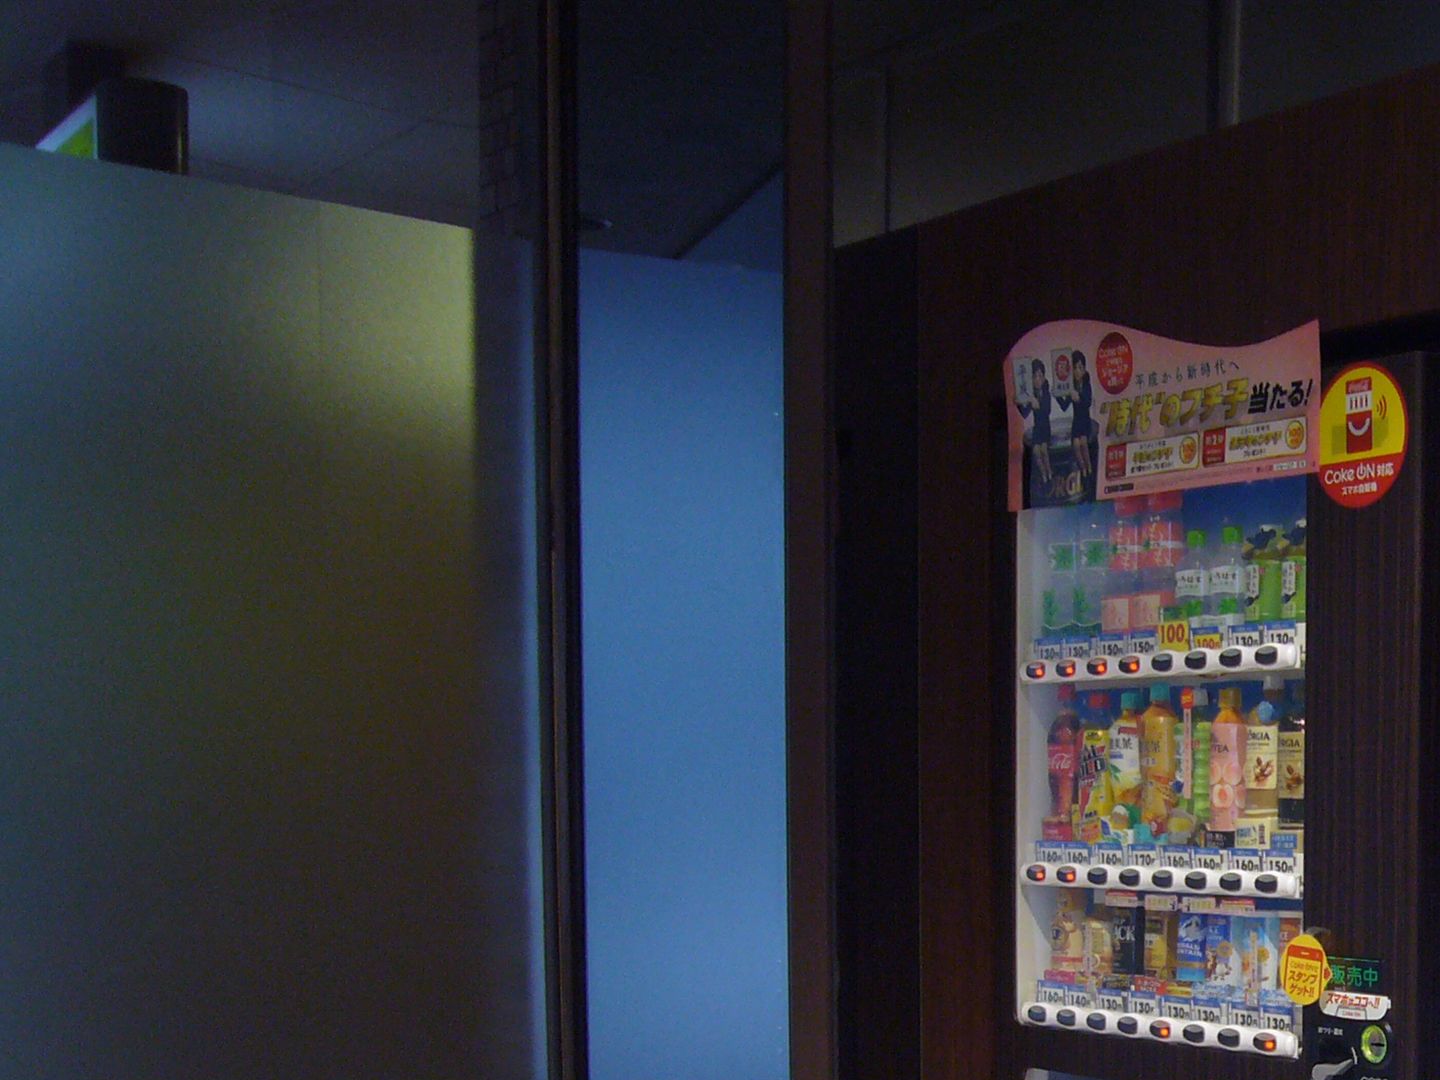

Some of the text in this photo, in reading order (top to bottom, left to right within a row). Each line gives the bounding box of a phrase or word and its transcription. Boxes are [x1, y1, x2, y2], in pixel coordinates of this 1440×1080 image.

[1324, 467, 1355, 485] Coke
[1288, 970, 1318, 985] スタンプ
[1330, 966, 1379, 988] 販売中
